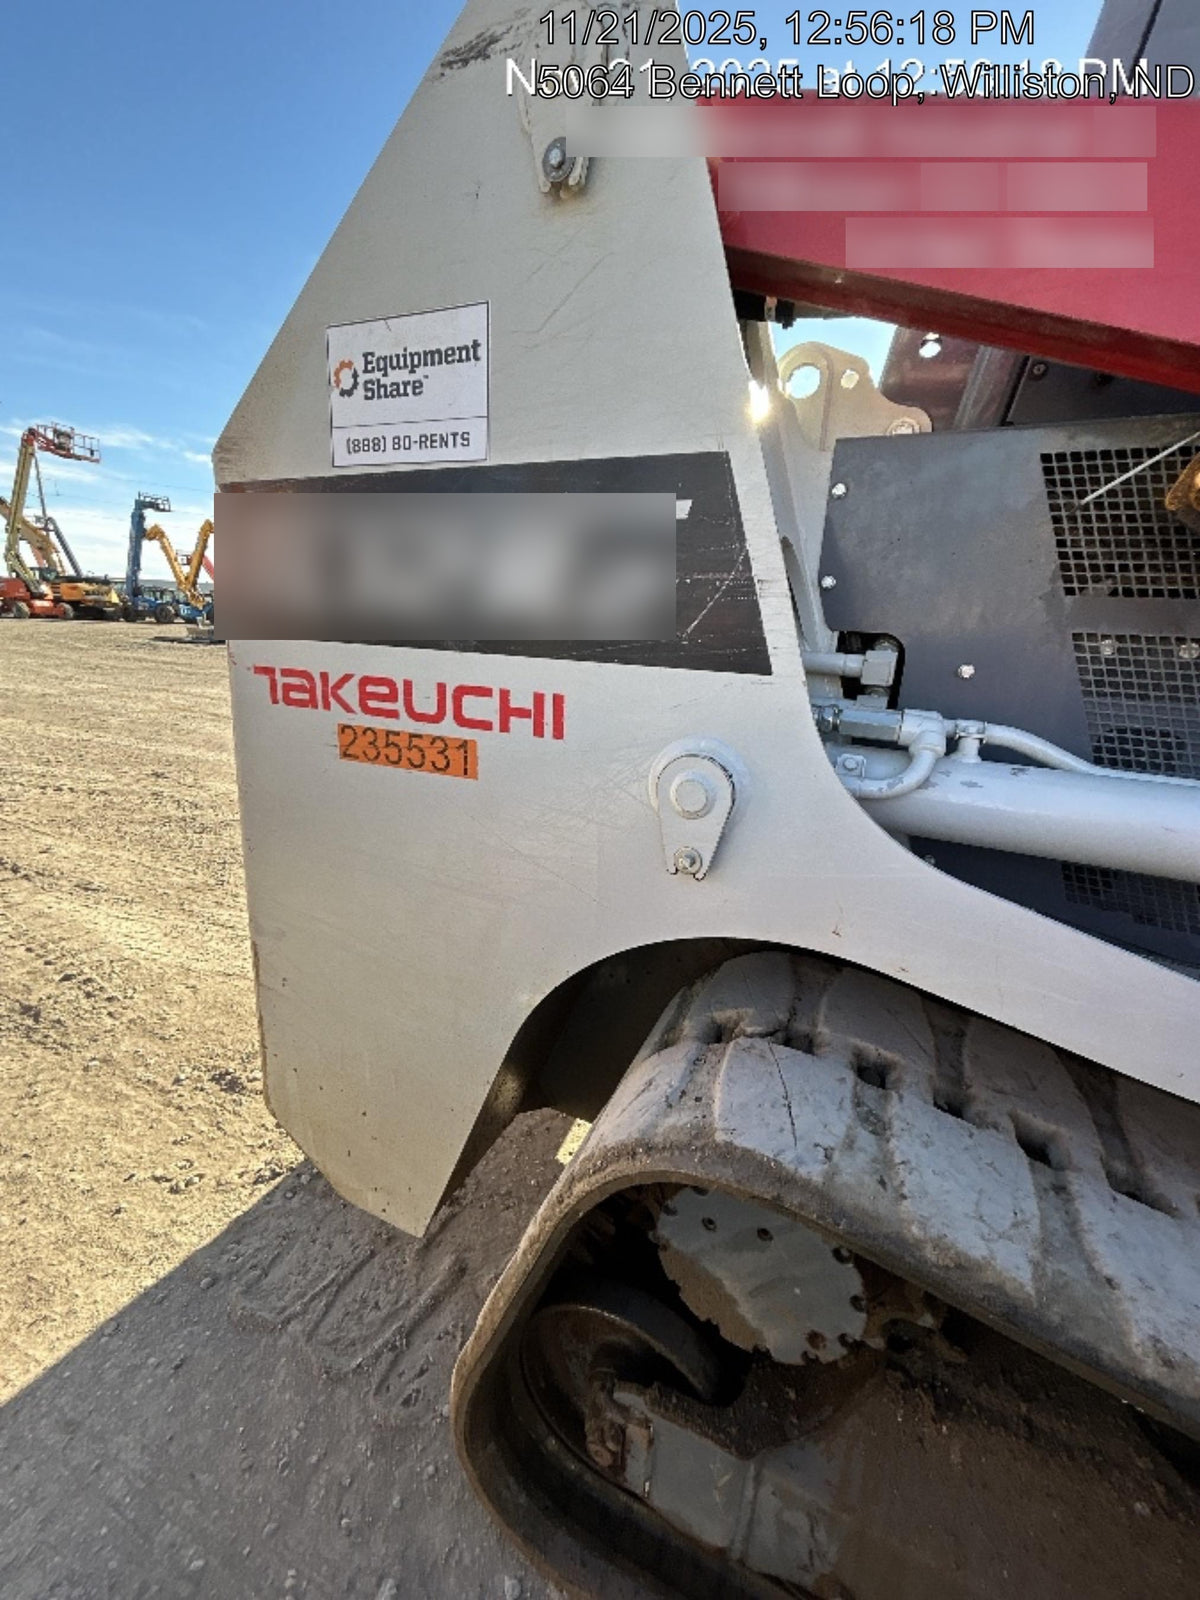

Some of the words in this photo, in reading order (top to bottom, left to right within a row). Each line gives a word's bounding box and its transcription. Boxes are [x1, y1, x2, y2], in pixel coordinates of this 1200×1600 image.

[362, 339, 481, 377] Equipment
[346, 437, 387, 455] (888)
[392, 431, 471, 451] 80-RENTS
[340, 725, 469, 776] 235531
